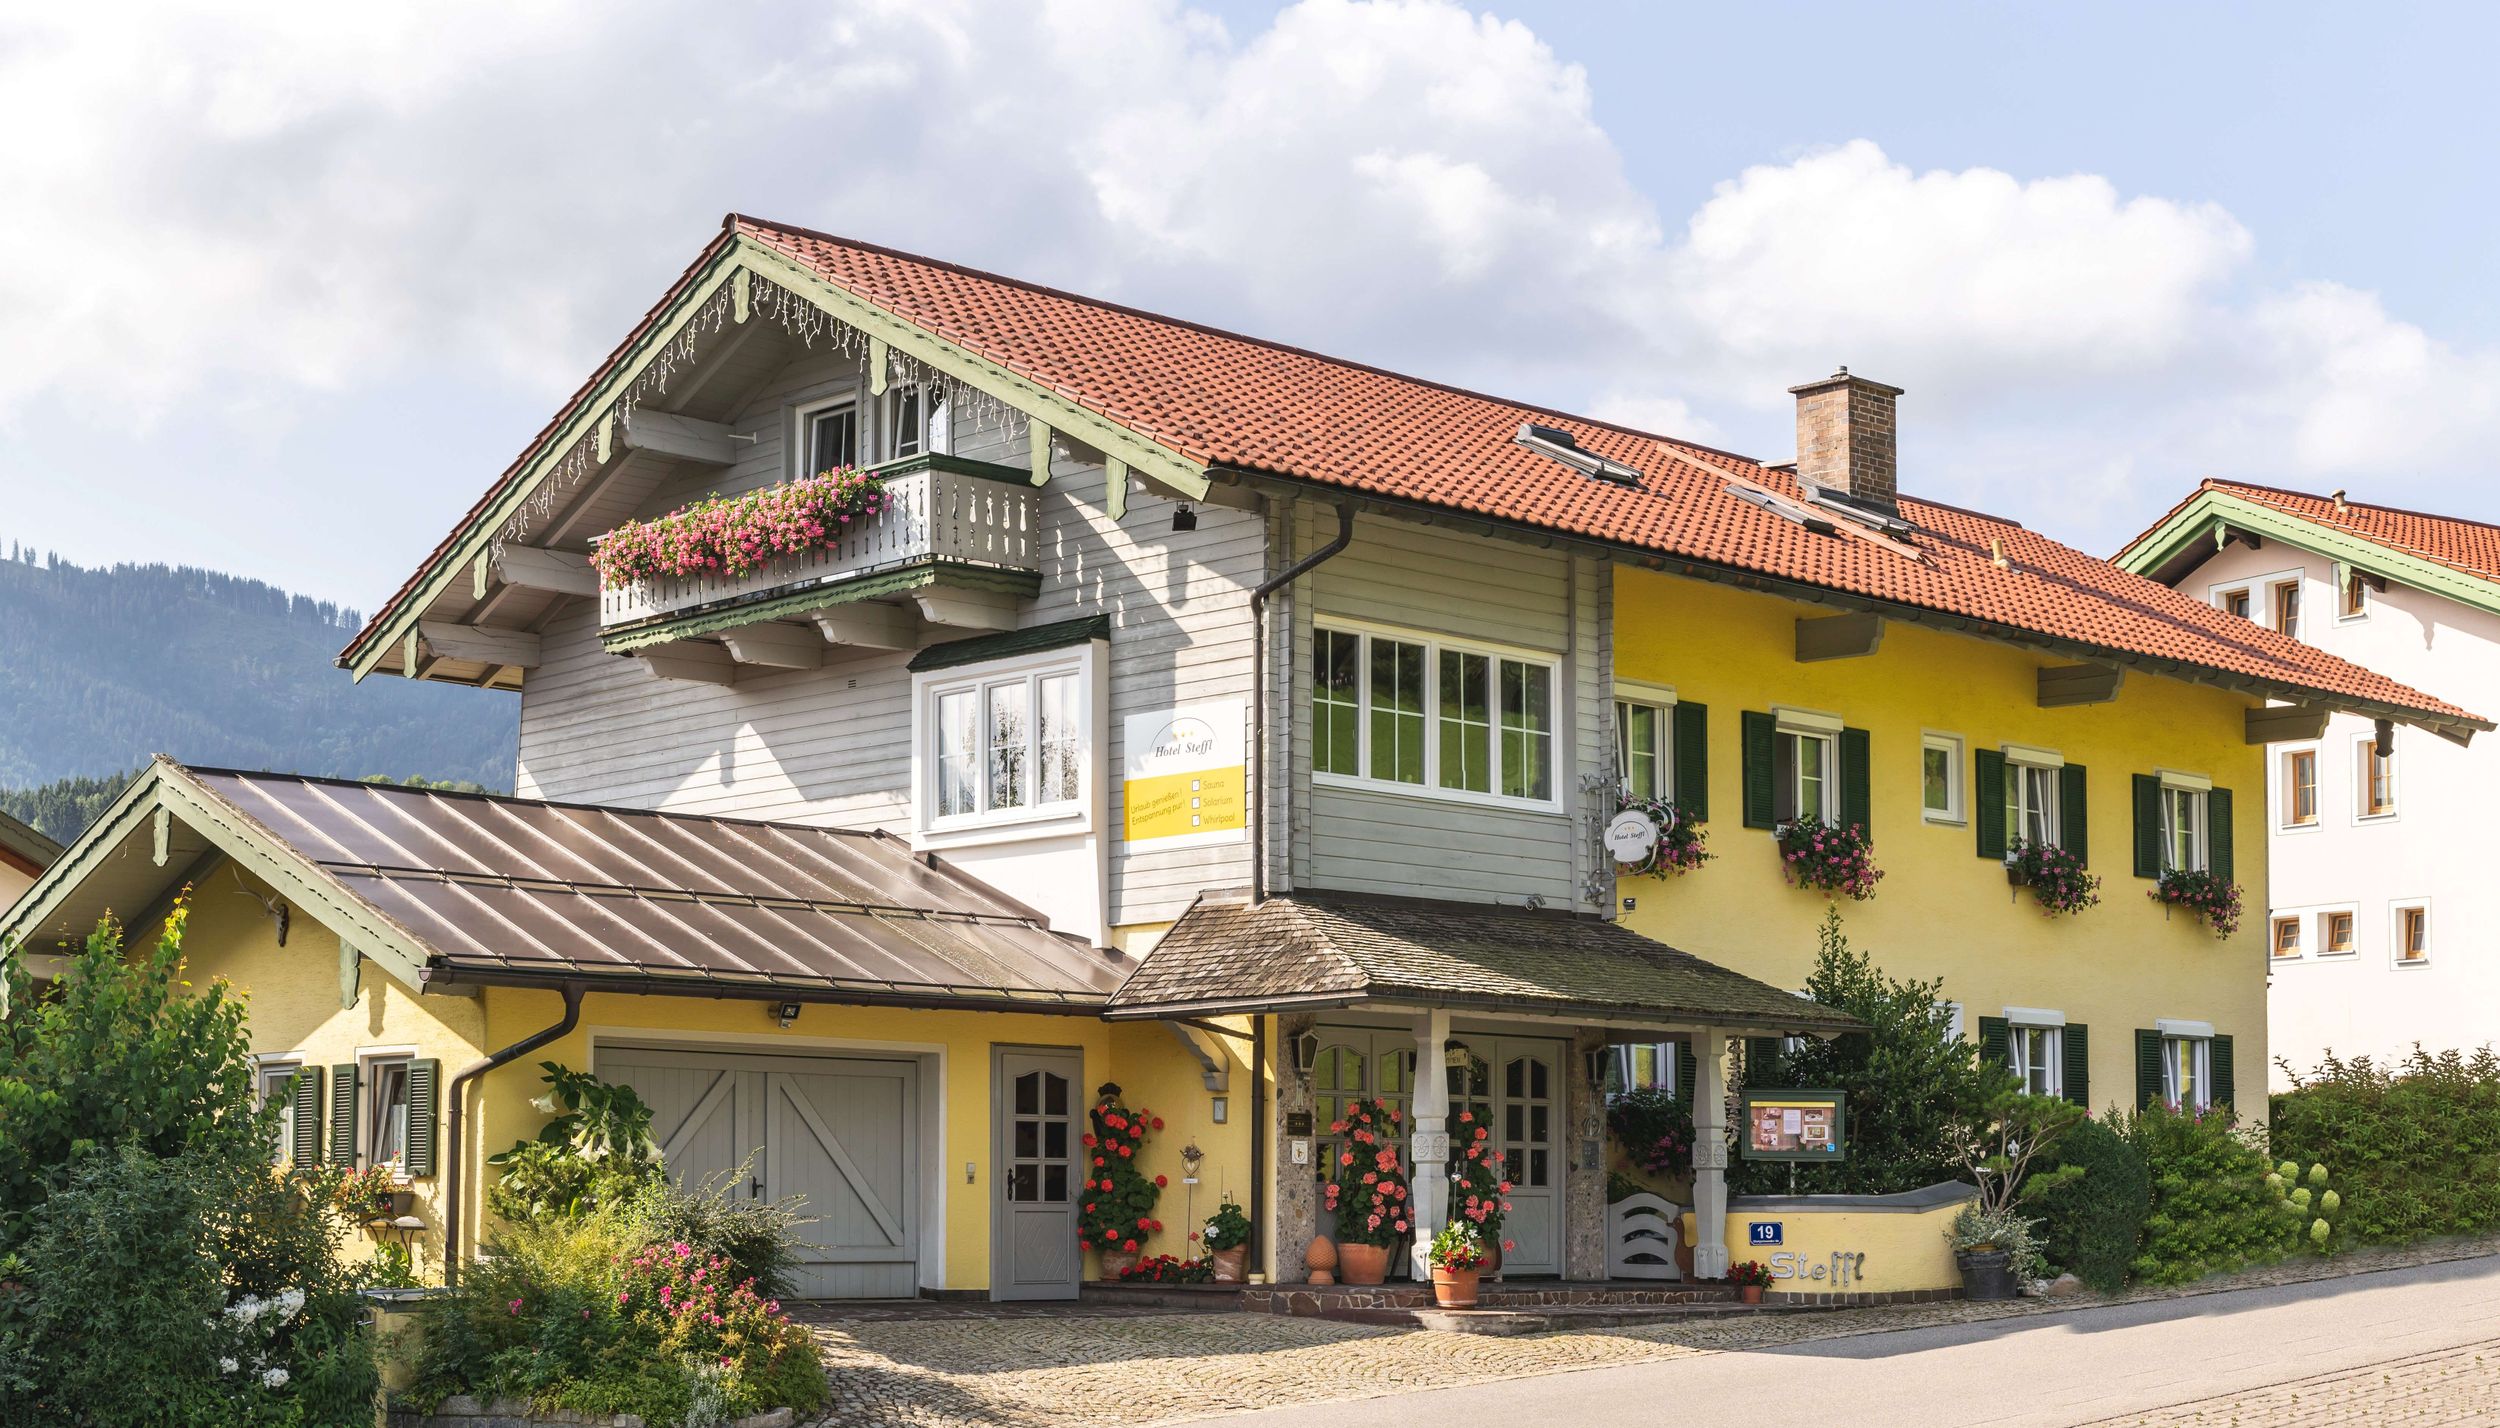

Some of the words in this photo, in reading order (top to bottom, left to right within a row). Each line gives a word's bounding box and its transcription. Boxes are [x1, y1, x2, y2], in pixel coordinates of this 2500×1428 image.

[1155, 742, 1181, 757] Hotel
[1185, 739, 1213, 755] Steffl
[1202, 780, 1224, 790] Sauna
[1131, 801, 1151, 814] Urlaub
[1202, 796, 1233, 807] Solarium
[1132, 806, 1172, 826] Entspannung
[1203, 812, 1235, 824] Whirlpool
[1757, 1225, 1774, 1239] 19
[1770, 1251, 1865, 1287] Steffl
